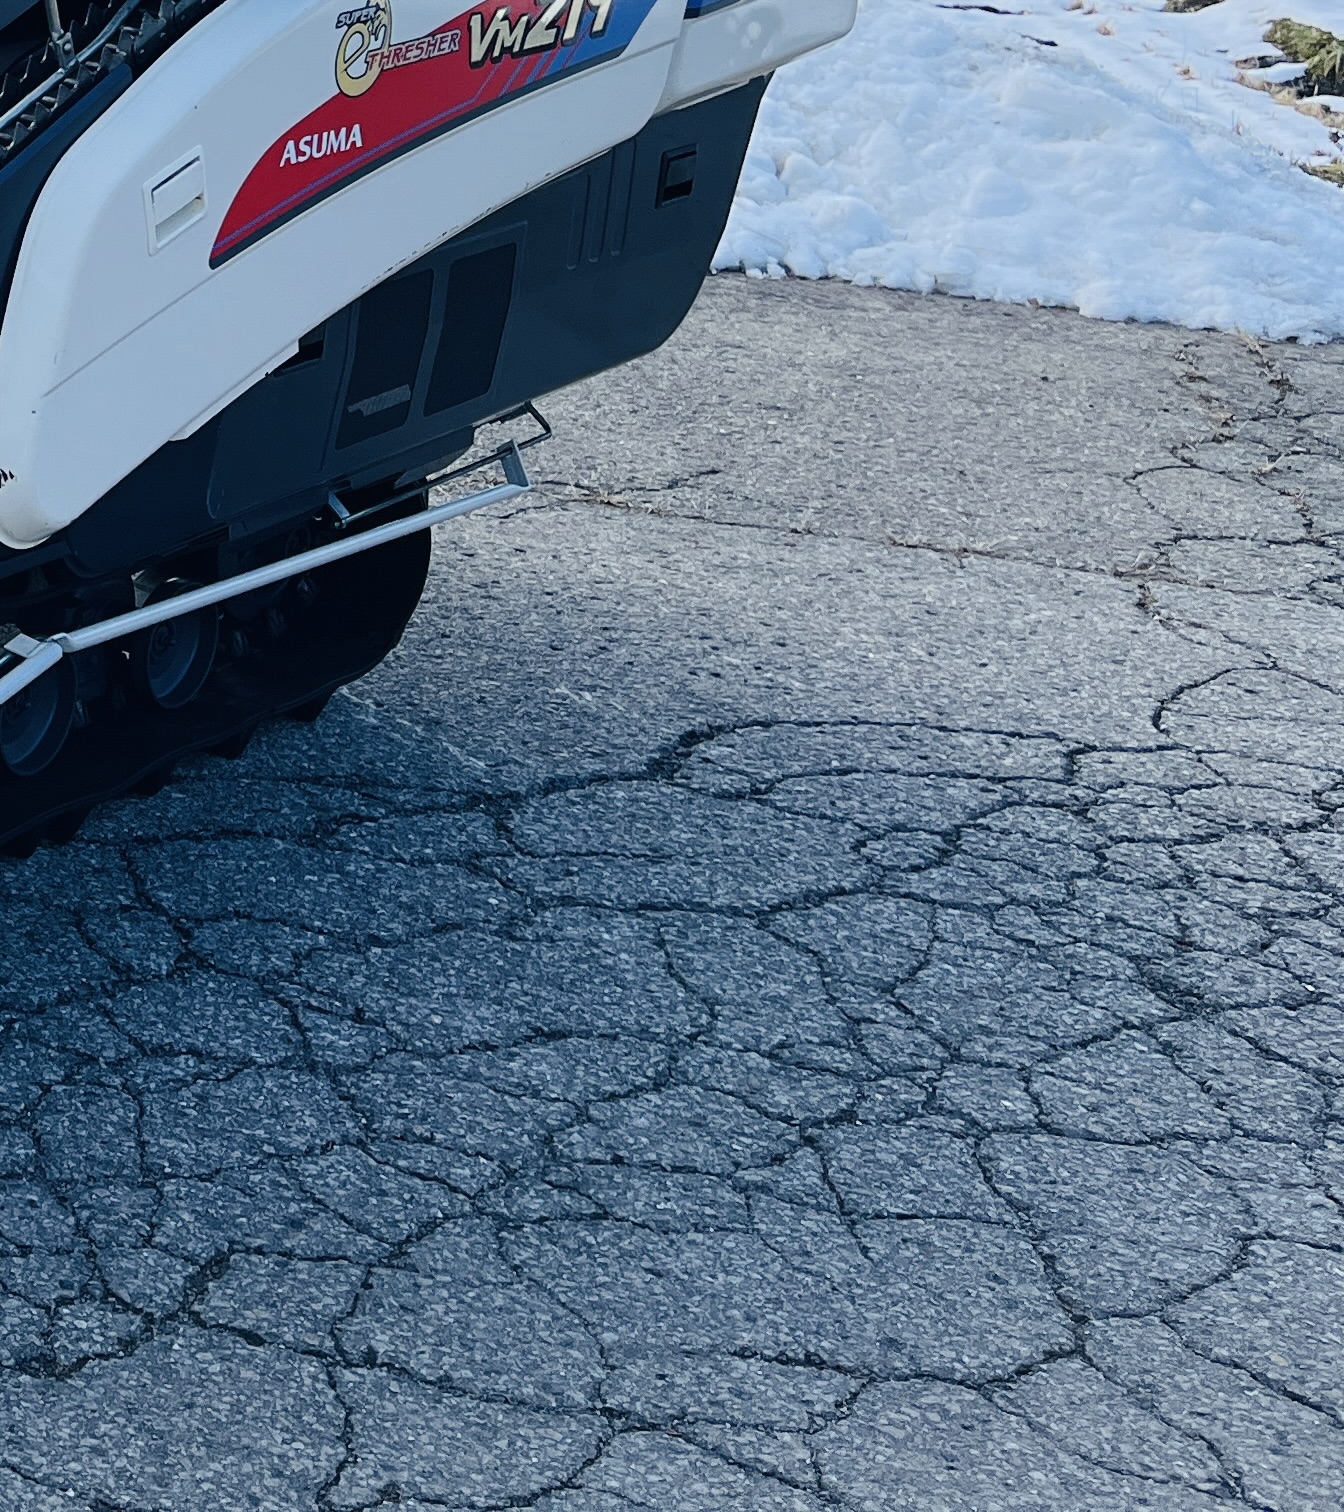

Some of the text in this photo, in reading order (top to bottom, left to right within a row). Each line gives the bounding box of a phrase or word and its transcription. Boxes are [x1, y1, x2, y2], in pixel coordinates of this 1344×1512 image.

[336, 7, 377, 27] SUPER
[367, 30, 460, 71] THRESHER
[279, 123, 363, 168] ASUMA
